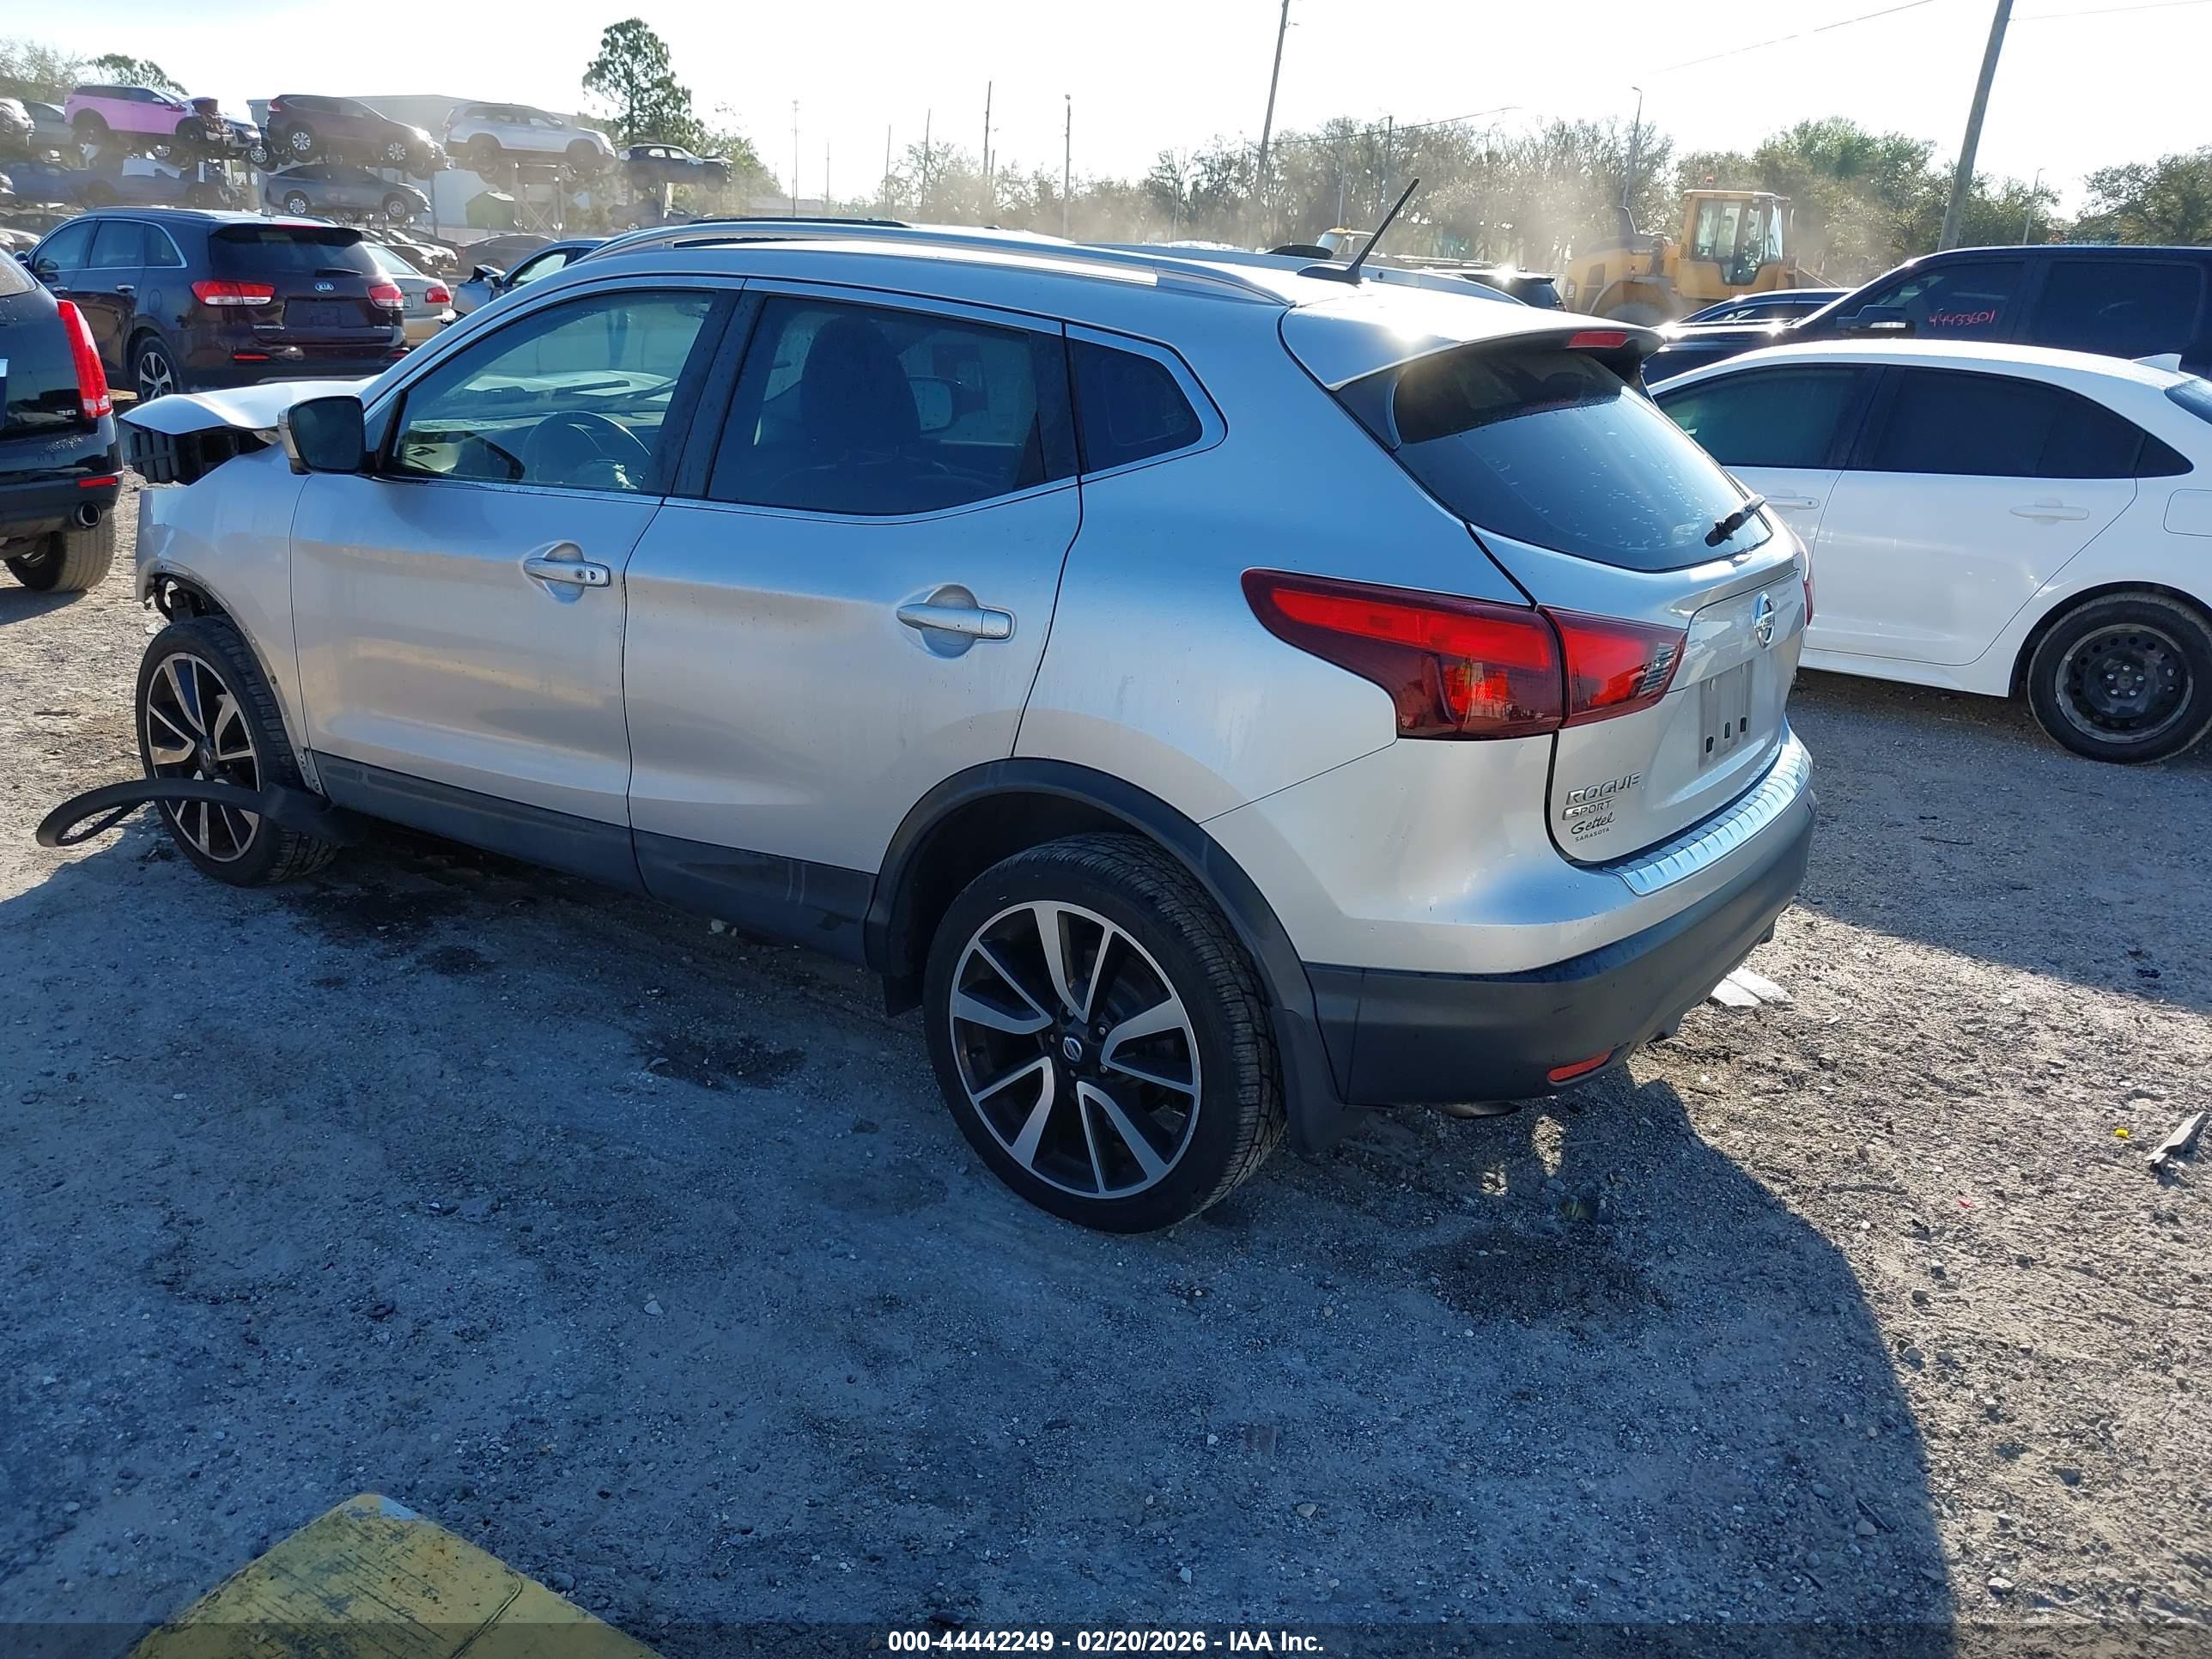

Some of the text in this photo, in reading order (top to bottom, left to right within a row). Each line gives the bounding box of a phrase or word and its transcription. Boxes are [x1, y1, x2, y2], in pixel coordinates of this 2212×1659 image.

[1929, 309, 1996, 327] 44433601
[1566, 771, 1642, 805] ROGUE
[1571, 799, 1615, 818] SPORT
[1571, 811, 1616, 835] Gettel
[1575, 827, 1610, 842] SARASOTA
